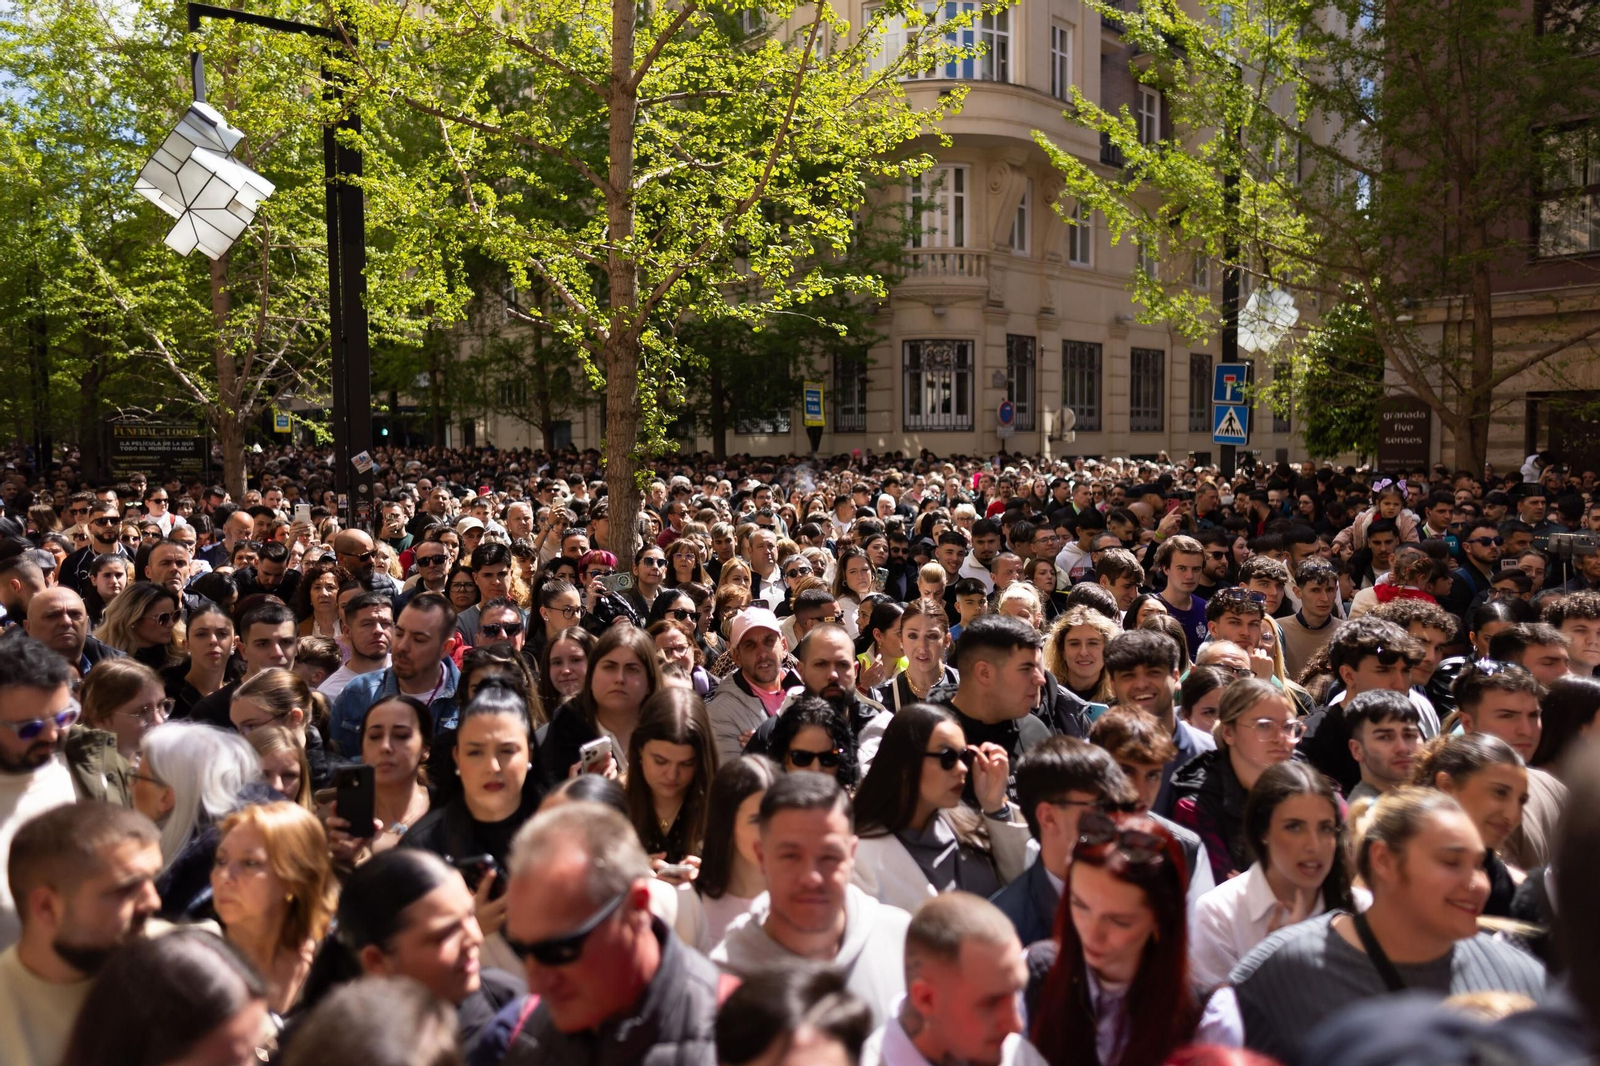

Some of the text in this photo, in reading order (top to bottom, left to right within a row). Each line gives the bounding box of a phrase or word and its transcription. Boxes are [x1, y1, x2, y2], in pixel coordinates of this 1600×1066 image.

[1383, 411, 1426, 421] granada
[1394, 423, 1414, 432] five
[114, 428, 158, 436] FUNERAL
[166, 428, 198, 436] LOCOS
[1385, 436, 1422, 444] senses
